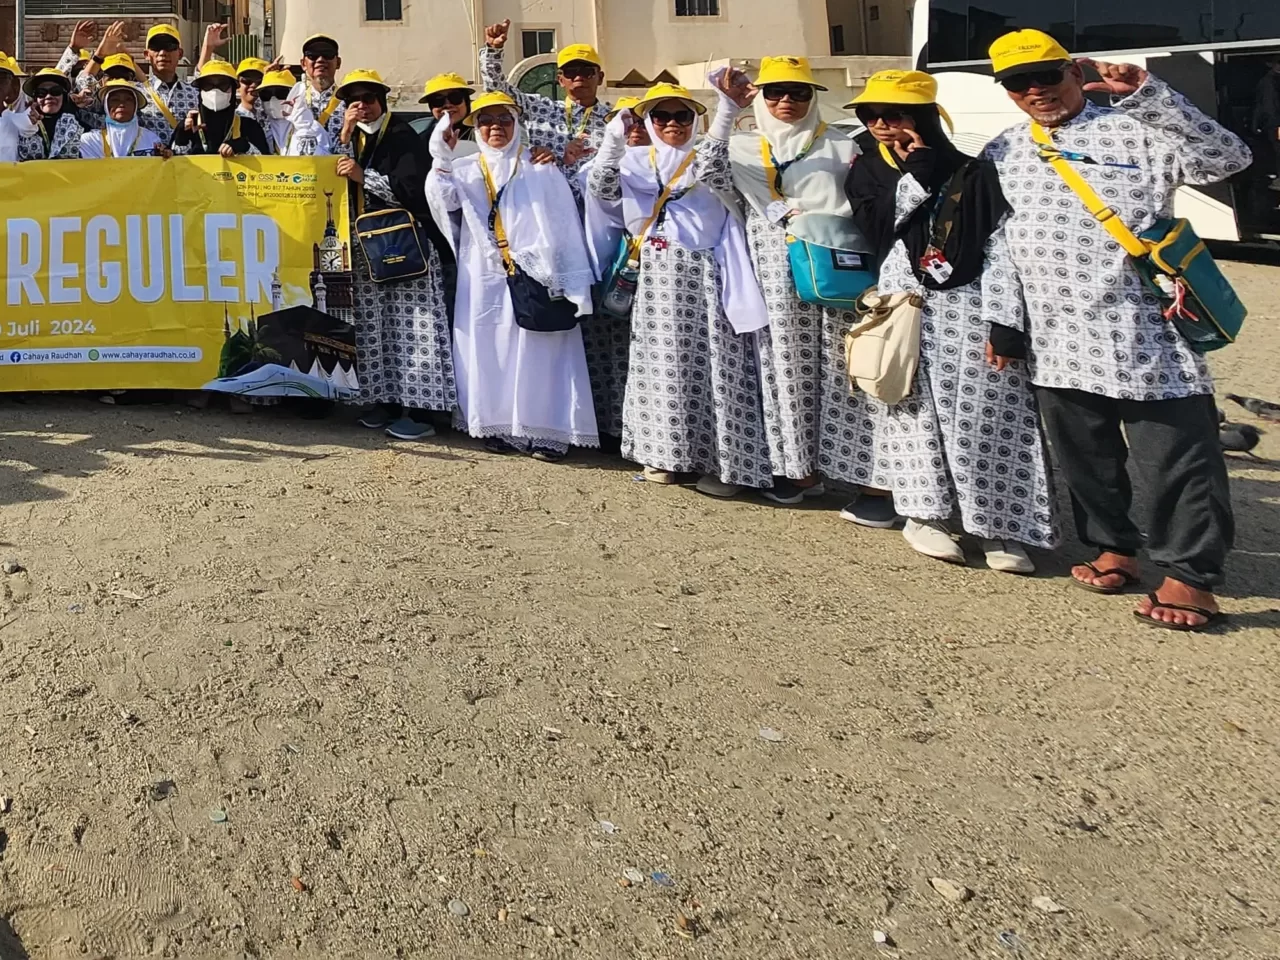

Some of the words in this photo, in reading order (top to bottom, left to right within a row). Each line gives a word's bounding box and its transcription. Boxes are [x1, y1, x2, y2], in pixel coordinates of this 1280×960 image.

[6, 213, 281, 306] REGULER
[7, 320, 40, 337] Juli
[50, 319, 96, 335] 2024
[22, 352, 50, 361] Cahaya
[51, 351, 82, 359] Raudhah
[102, 350, 196, 360] www.cahayaraudhah.co.id
